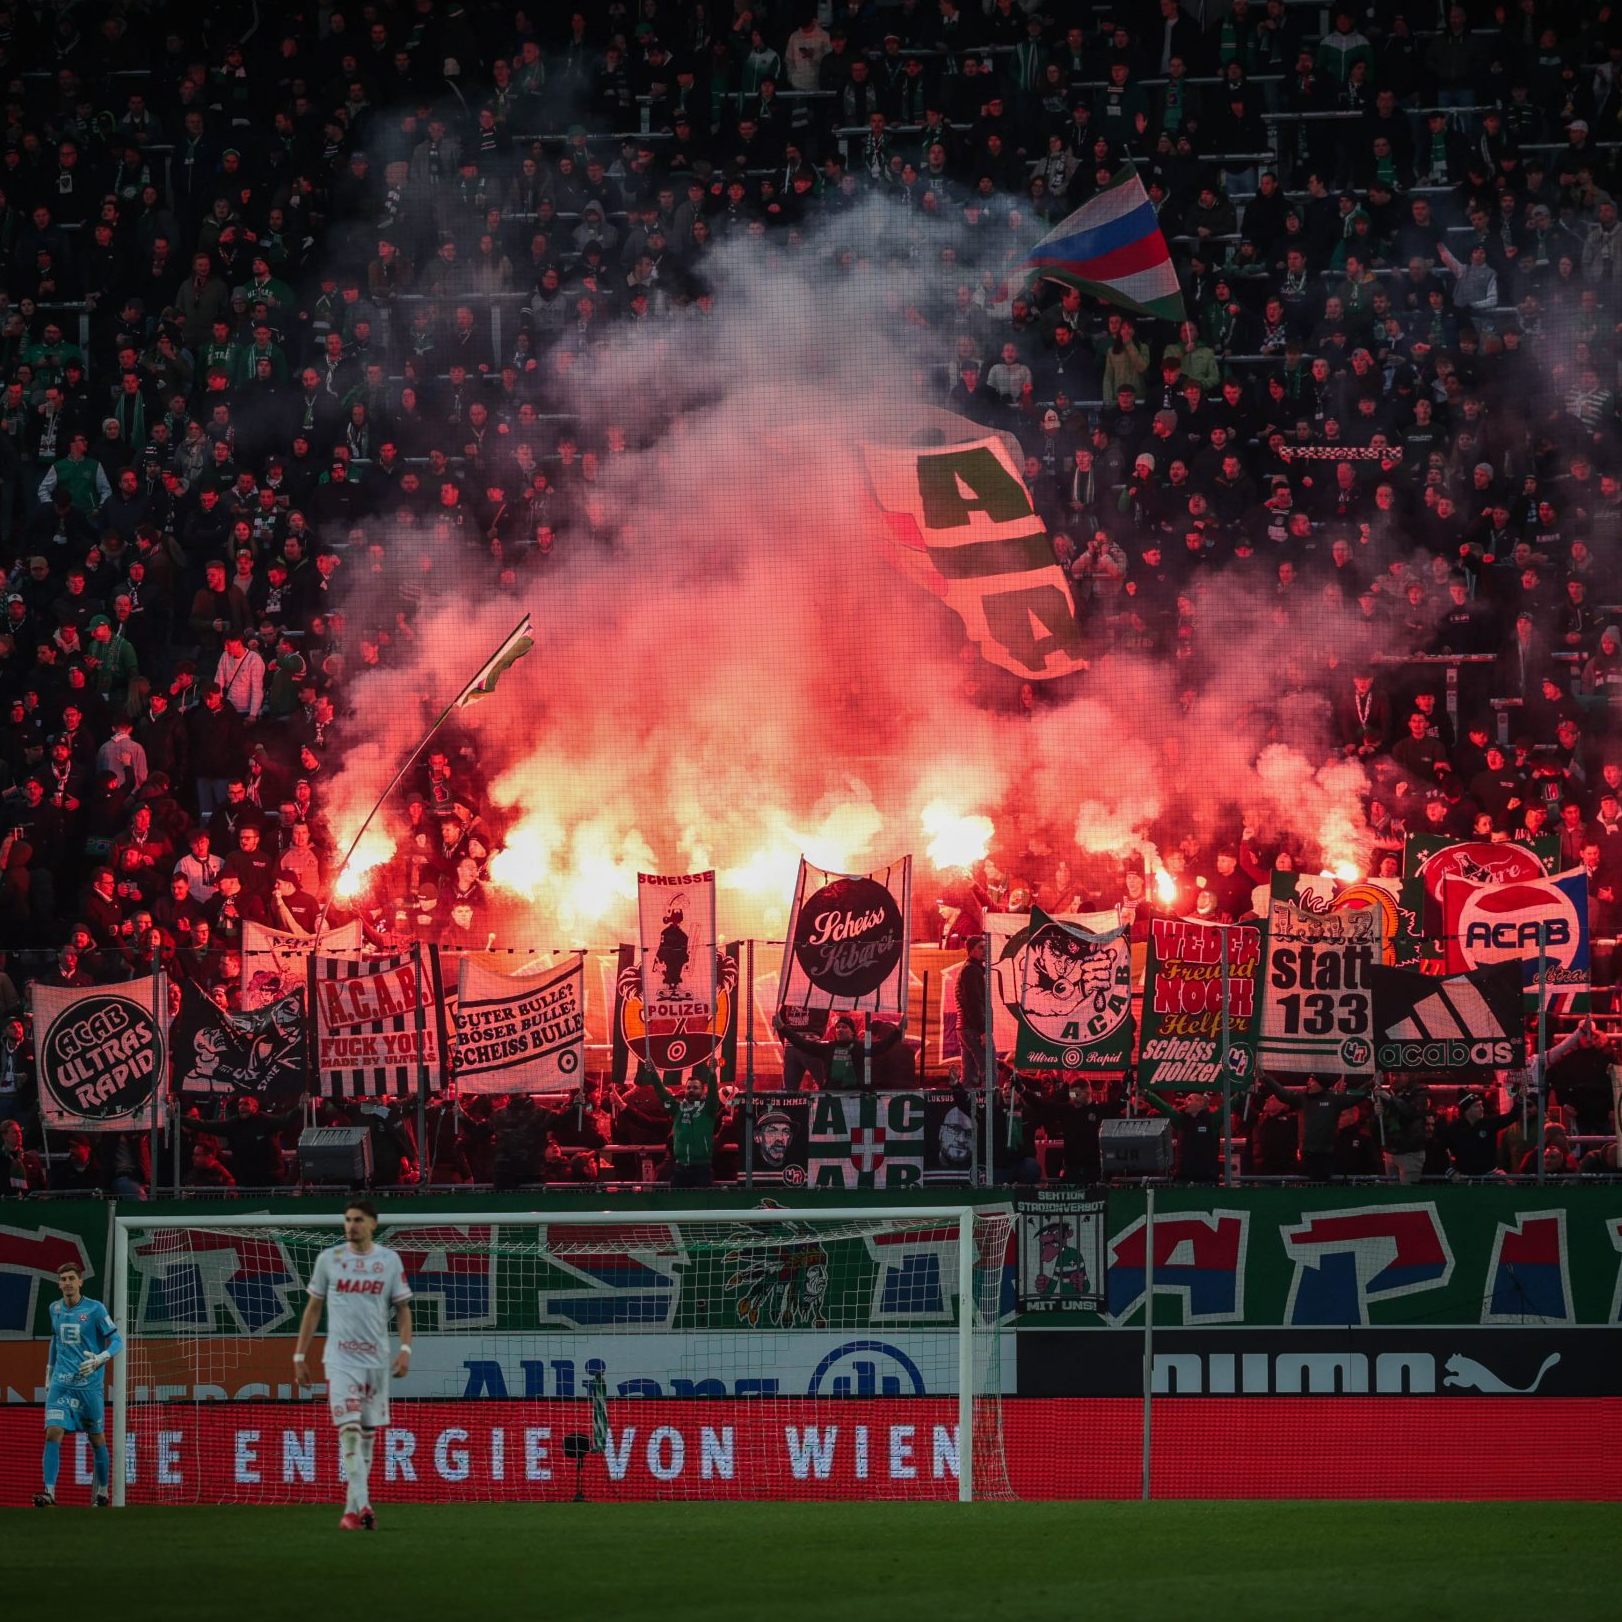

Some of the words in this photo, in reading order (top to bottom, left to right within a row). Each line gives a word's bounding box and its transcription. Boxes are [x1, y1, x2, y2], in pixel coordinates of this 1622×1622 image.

[638, 872, 713, 886] SCHEISSE
[809, 906, 885, 945] Scheiss
[1152, 918, 1261, 965] WEDER
[1273, 904, 1375, 945] 1312
[1465, 918, 1571, 948] ACAB
[1163, 957, 1255, 982] Freund
[1272, 946, 1374, 990] statt
[324, 966, 430, 1025] A.C.A.B.
[455, 1007, 517, 1029] GUTER
[518, 983, 574, 1017] BULLE?
[647, 1003, 709, 1017] POLIZEI
[1154, 974, 1254, 1017] NOCH
[1276, 993, 1369, 1034] 133
[55, 1003, 129, 1060] ACAB
[458, 1023, 518, 1046] BÖSER
[521, 999, 577, 1031] BULLE?
[1159, 1011, 1248, 1038] Helfer
[57, 1021, 154, 1088] ULTRAS
[320, 1036, 378, 1058] FUCK
[382, 1030, 434, 1055] YOU!
[321, 1057, 359, 1068] MADE
[361, 1057, 380, 1066] BY
[384, 1052, 437, 1065] ULTRS
[453, 1035, 528, 1069] SCHEISS
[1026, 1051, 1058, 1063] Ultras
[1086, 1051, 1123, 1066] Rapid
[1142, 1037, 1217, 1060] scheiss
[75, 1049, 156, 1110] RAPID
[864, 1200, 1622, 1327] RAPI
[336, 1279, 385, 1295] MAPEI
[1026, 1300, 1057, 1312] MIT
[1061, 1300, 1098, 1311] UNS!
[234, 1427, 551, 1484] ENRGIE
[604, 1426, 734, 1480] VON
[785, 1425, 961, 1479] WIEN
